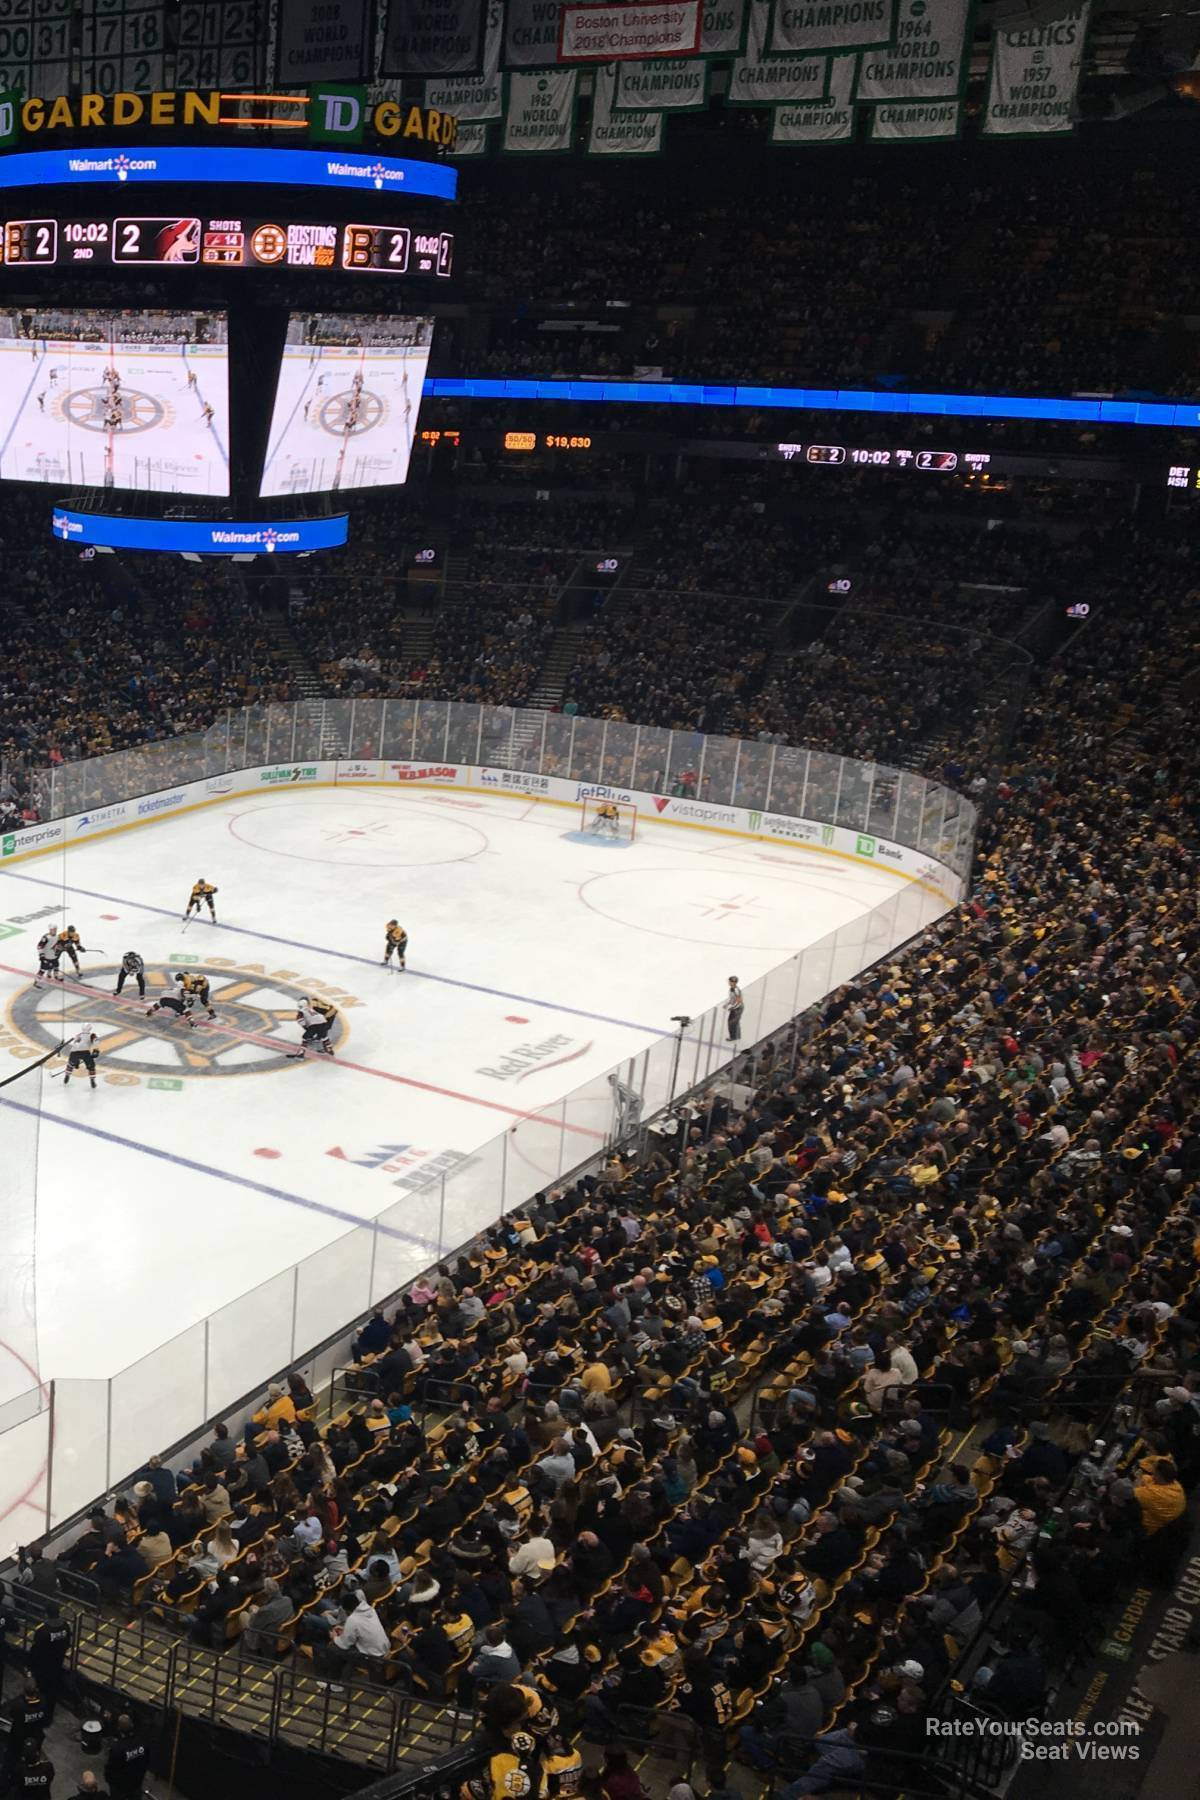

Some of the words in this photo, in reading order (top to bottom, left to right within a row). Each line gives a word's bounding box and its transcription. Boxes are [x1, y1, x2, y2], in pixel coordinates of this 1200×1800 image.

[575, 15, 619, 29] Boston
[623, 11, 686, 29] University
[899, 20, 931, 37] 1964
[39, 24, 68, 57] 31
[85, 19, 120, 53] 17
[129, 15, 160, 48] 18
[304, 24, 349, 44] WORLD
[608, 31, 682, 49] Champions
[1005, 25, 1076, 48] CELTICS
[287, 43, 362, 65] CHAMPIONS
[84, 63, 116, 94] 10
[134, 59, 152, 92] 2
[738, 63, 820, 85] CHAMPIONS
[864, 60, 955, 82] CHAMPIONS
[1022, 67, 1052, 83] 1957
[622, 73, 701, 92] CHAMPIONS
[429, 87, 498, 105] CHAMPIONS
[1009, 84, 1058, 101] WORLD
[21, 90, 221, 133] GARDEN
[319, 94, 360, 132] TD
[522, 109, 560, 124] WORLD
[779, 109, 850, 127] CHAMPIONS
[878, 105, 954, 124] CHAMPIONS
[991, 99, 1071, 120] CHAMPIONS
[594, 124, 657, 140] CHAMPIONS
[69, 159, 113, 171] Walmart
[327, 162, 372, 177] Walmart
[209, 220, 242, 232] SHOTS
[35, 227, 50, 255] 2
[63, 223, 108, 242] 10:02
[121, 224, 141, 253] 2
[224, 235, 238, 246] 14
[389, 234, 404, 262] 2
[414, 235, 439, 255] 10:02
[72, 248, 93, 259] 2ND
[223, 251, 237, 261] 17
[287, 245, 316, 265] TEAM
[546, 435, 592, 449] $19,630
[783, 452, 794, 460] 17
[829, 449, 839, 462] 2
[851, 450, 891, 465] 10:02
[922, 454, 932, 467] 2
[971, 462, 983, 472] 14
[1169, 466, 1190, 477] DET
[212, 531, 261, 544] Walmart
[575, 783, 631, 803] jetBlue
[137, 793, 185, 816] ticketmaster
[672, 802, 736, 825] vistaprint
[4, 826, 62, 851] enterprise
[475, 1050, 525, 1082] Red
[520, 1032, 576, 1068] River
[1112, 1587, 1153, 1643] GARDEN
